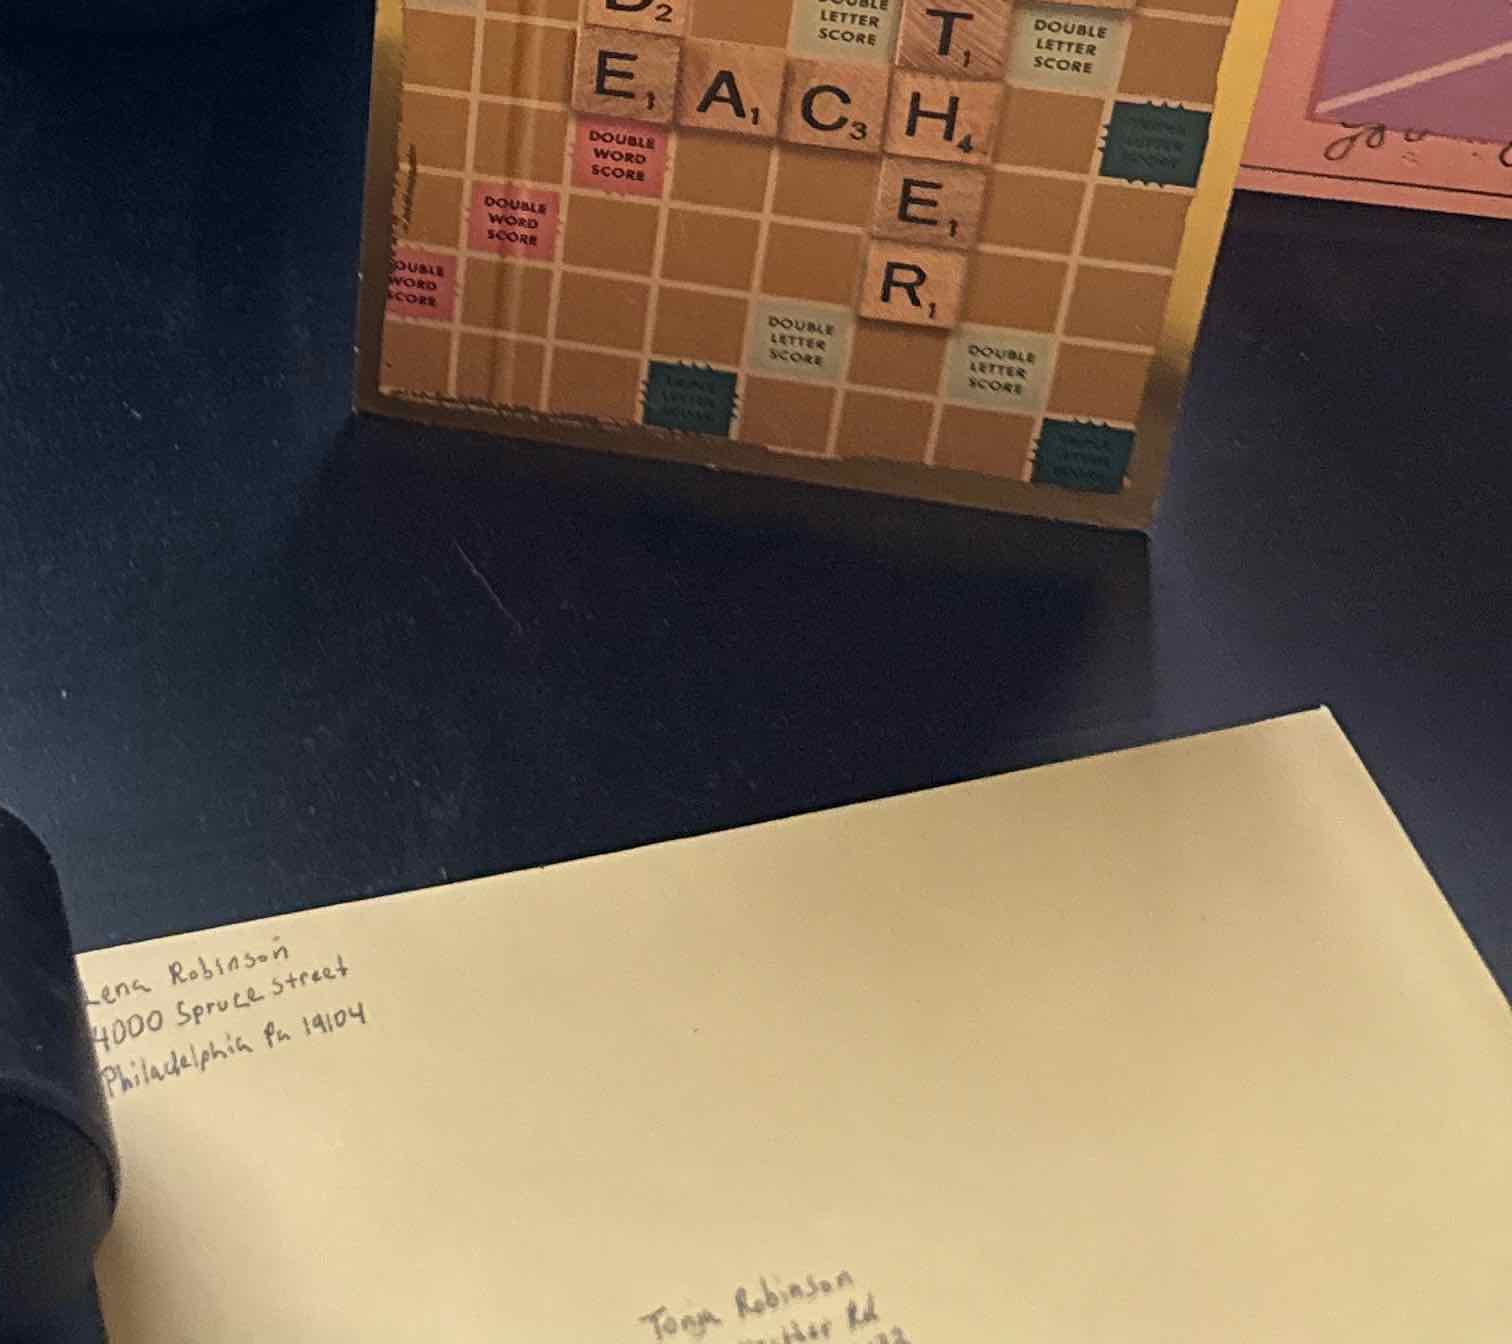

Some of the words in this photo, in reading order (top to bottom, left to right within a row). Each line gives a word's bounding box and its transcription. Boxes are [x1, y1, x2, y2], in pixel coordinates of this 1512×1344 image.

[820, 9, 879, 29] LETTER
[1034, 18, 1108, 39] DOUBLE
[817, 26, 877, 46] SCORE
[1036, 37, 1097, 57] LETTER
[1033, 55, 1093, 74] SCORE
[589, 129, 656, 150] DOUBLE
[592, 146, 647, 165] WORD
[591, 163, 645, 182] SCORE
[483, 194, 547, 214] DOUBLE
[488, 211, 539, 230] WORD
[487, 228, 538, 247] SCORE
[392, 259, 444, 278] OUBLE
[768, 314, 835, 337] DOUBLE
[770, 332, 827, 352] LETTER
[768, 348, 825, 367] SCORE
[967, 344, 1035, 363] DOUBLE
[969, 361, 1027, 380] LETTER
[967, 377, 1023, 395] SCORE
[169, 937, 289, 986] Robinson
[92, 1009, 163, 1052] 4000
[177, 987, 264, 1026] Spruce
[272, 954, 349, 995] Street
[100, 1032, 254, 1099] Philadelphia
[304, 1002, 367, 1036] 19104
